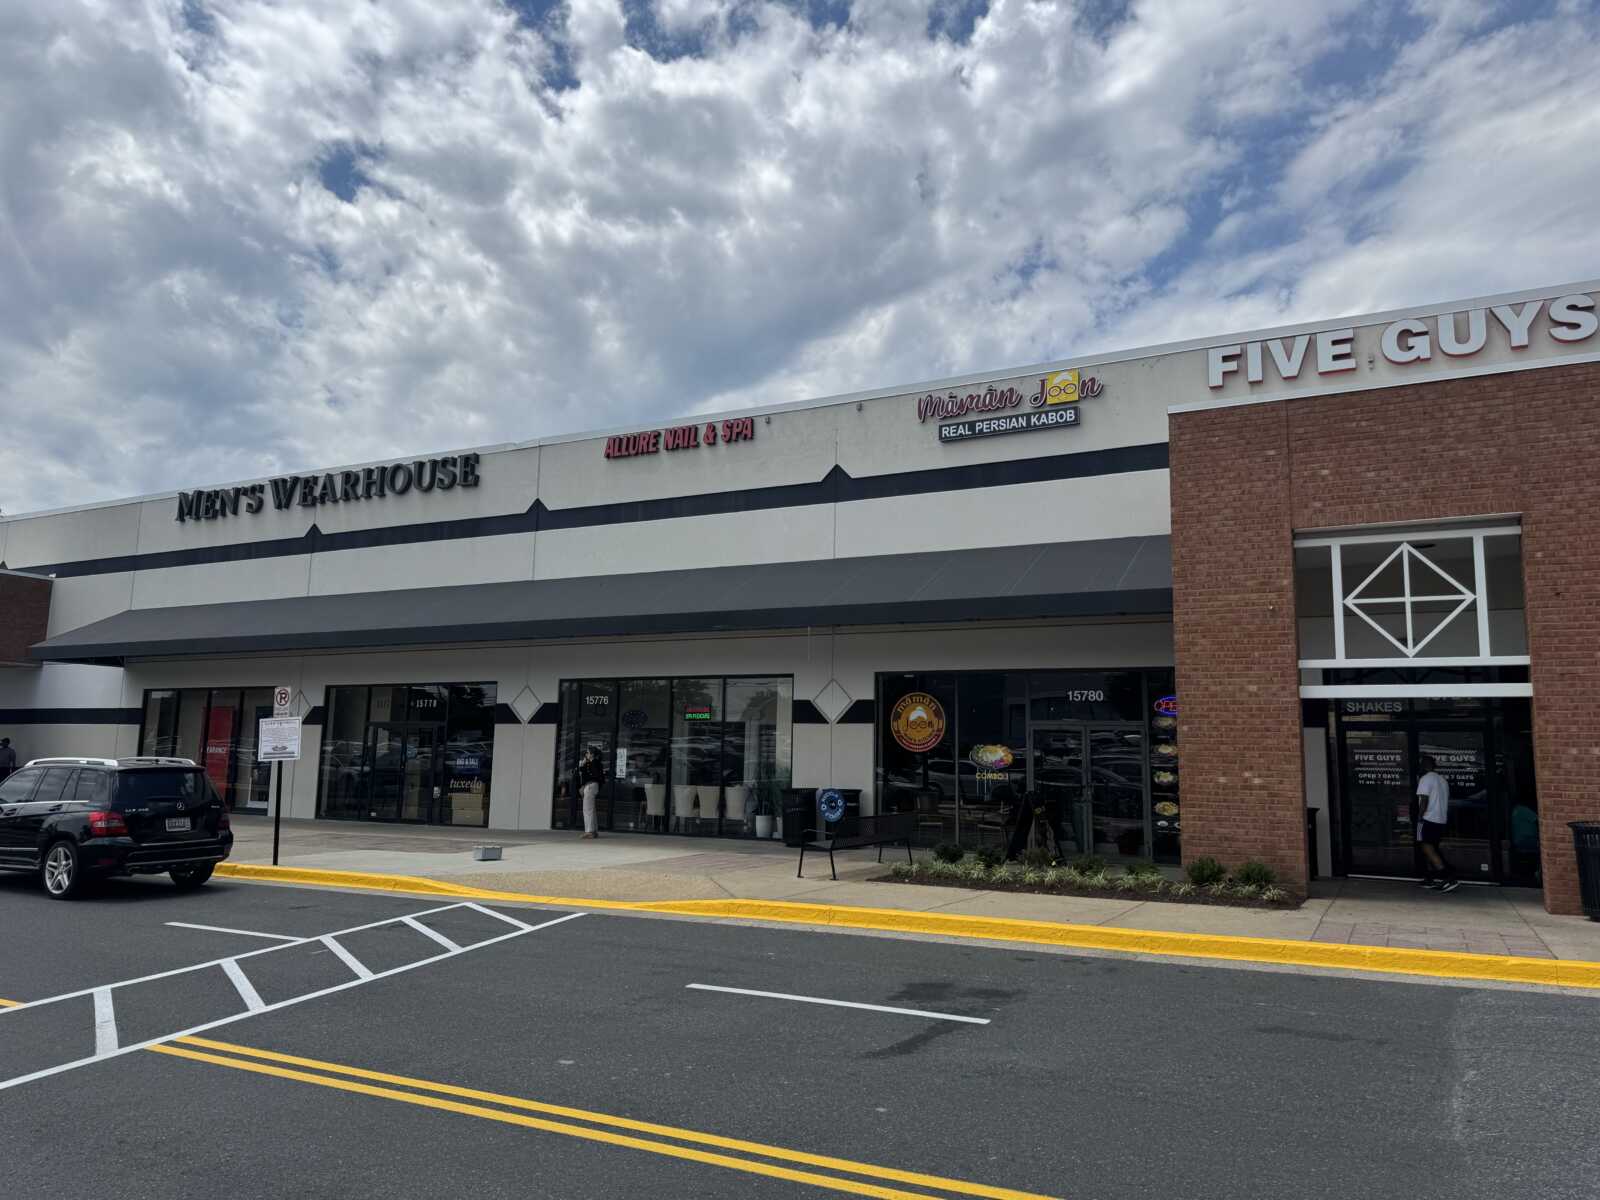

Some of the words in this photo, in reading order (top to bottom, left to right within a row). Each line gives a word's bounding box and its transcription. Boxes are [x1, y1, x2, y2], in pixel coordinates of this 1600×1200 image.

[1208, 329, 1357, 388] FIVE
[1381, 293, 1599, 365] GUYS
[941, 425, 972, 438] REAL
[975, 416, 1027, 433] PERSIAN
[1031, 409, 1075, 427] KABOB
[603, 430, 659, 458] ALLURE
[664, 424, 698, 452] NAIL
[703, 423, 716, 446] &
[721, 417, 754, 443] SPA
[176, 485, 263, 523] MEN'S
[269, 453, 480, 512] WEARHOUSE
[584, 696, 609, 705] 15776
[1066, 690, 1104, 702] 15780
[1345, 701, 1403, 713] SHAKES
[1449, 754, 1476, 762] GUYS
